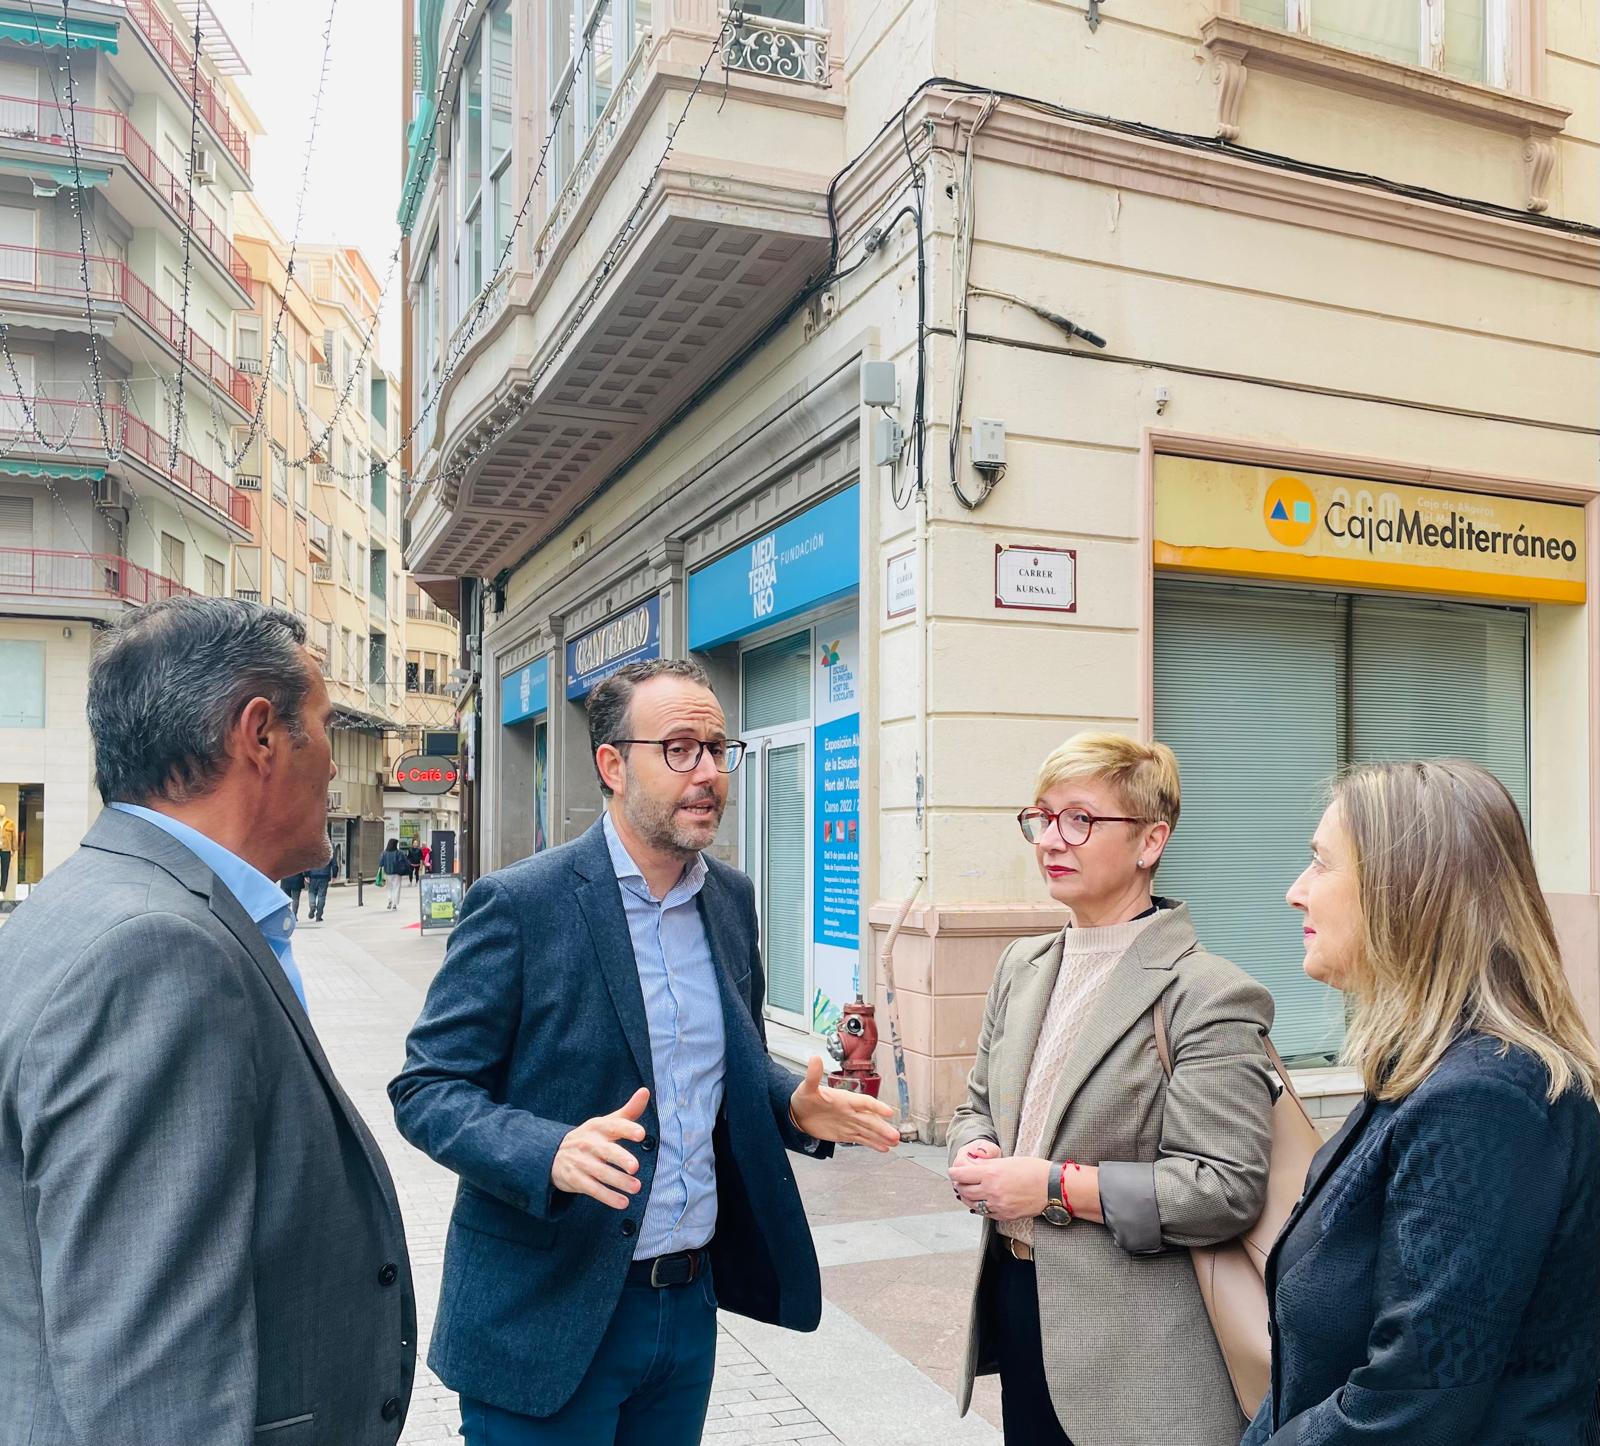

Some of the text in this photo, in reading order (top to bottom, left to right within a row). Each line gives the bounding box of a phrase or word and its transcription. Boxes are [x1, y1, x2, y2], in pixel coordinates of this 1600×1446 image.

[1324, 501, 1577, 562] CajaMediterráneo
[781, 532, 824, 567] FUNDACIÓN
[748, 561, 777, 595] TERRA
[1018, 568, 1053, 578] CARRER
[1016, 584, 1056, 595] KURSAAL
[753, 587, 774, 619] NEO
[825, 736, 852, 753] Exposición
[825, 758, 831, 771] de
[832, 758, 837, 770] la
[838, 755, 857, 770] Escuela
[409, 768, 442, 782] Café
[825, 779, 836, 792] Hort
[837, 778, 845, 790] del
[825, 799, 839, 813] Curso
[840, 799, 852, 812] 2022
